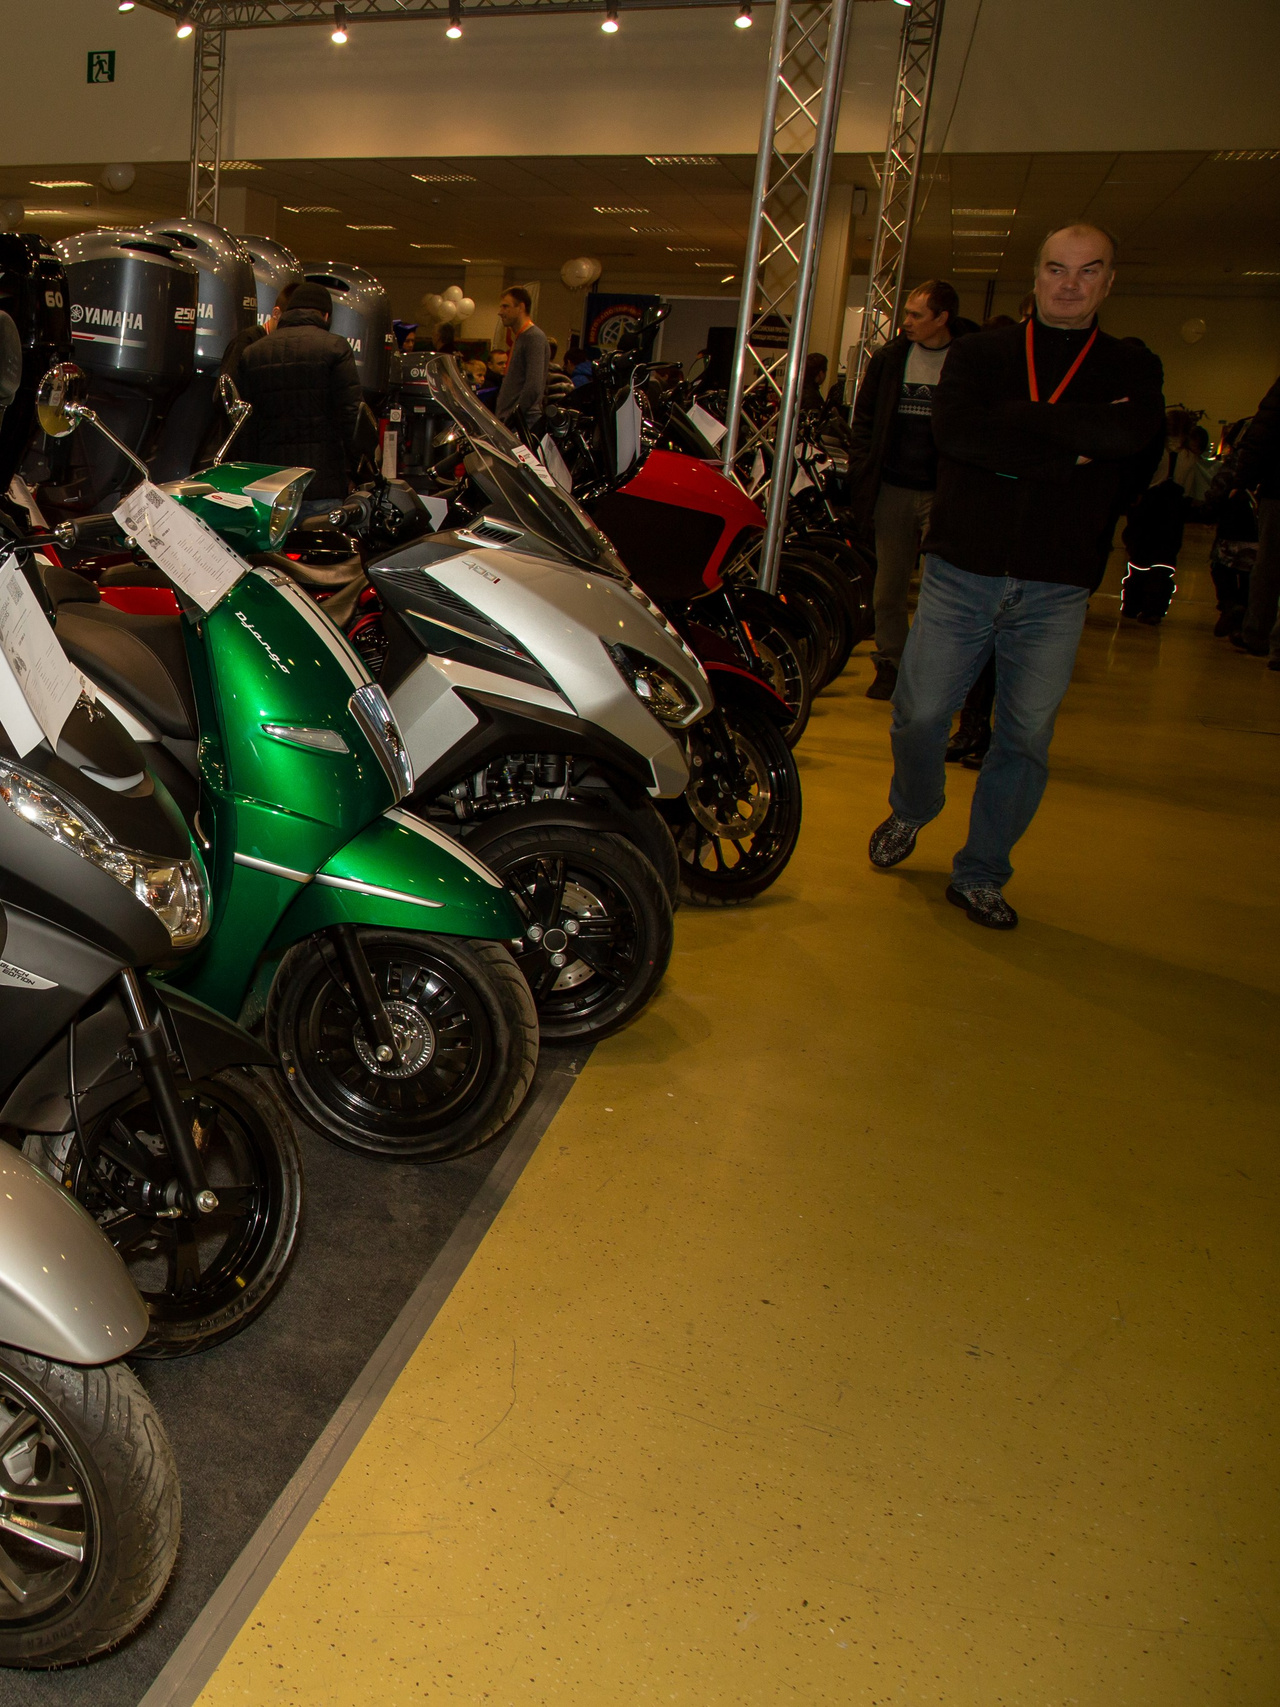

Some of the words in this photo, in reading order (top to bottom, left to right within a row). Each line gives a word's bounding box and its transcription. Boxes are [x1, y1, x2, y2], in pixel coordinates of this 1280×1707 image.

[45, 290, 63, 308] 60
[84, 307, 144, 331] YAMAHA
[174, 307, 196, 320] 250
[234, 610, 290, 675] Django
[0, 962, 30, 977] BLACK
[1, 968, 36, 986] EDITION
